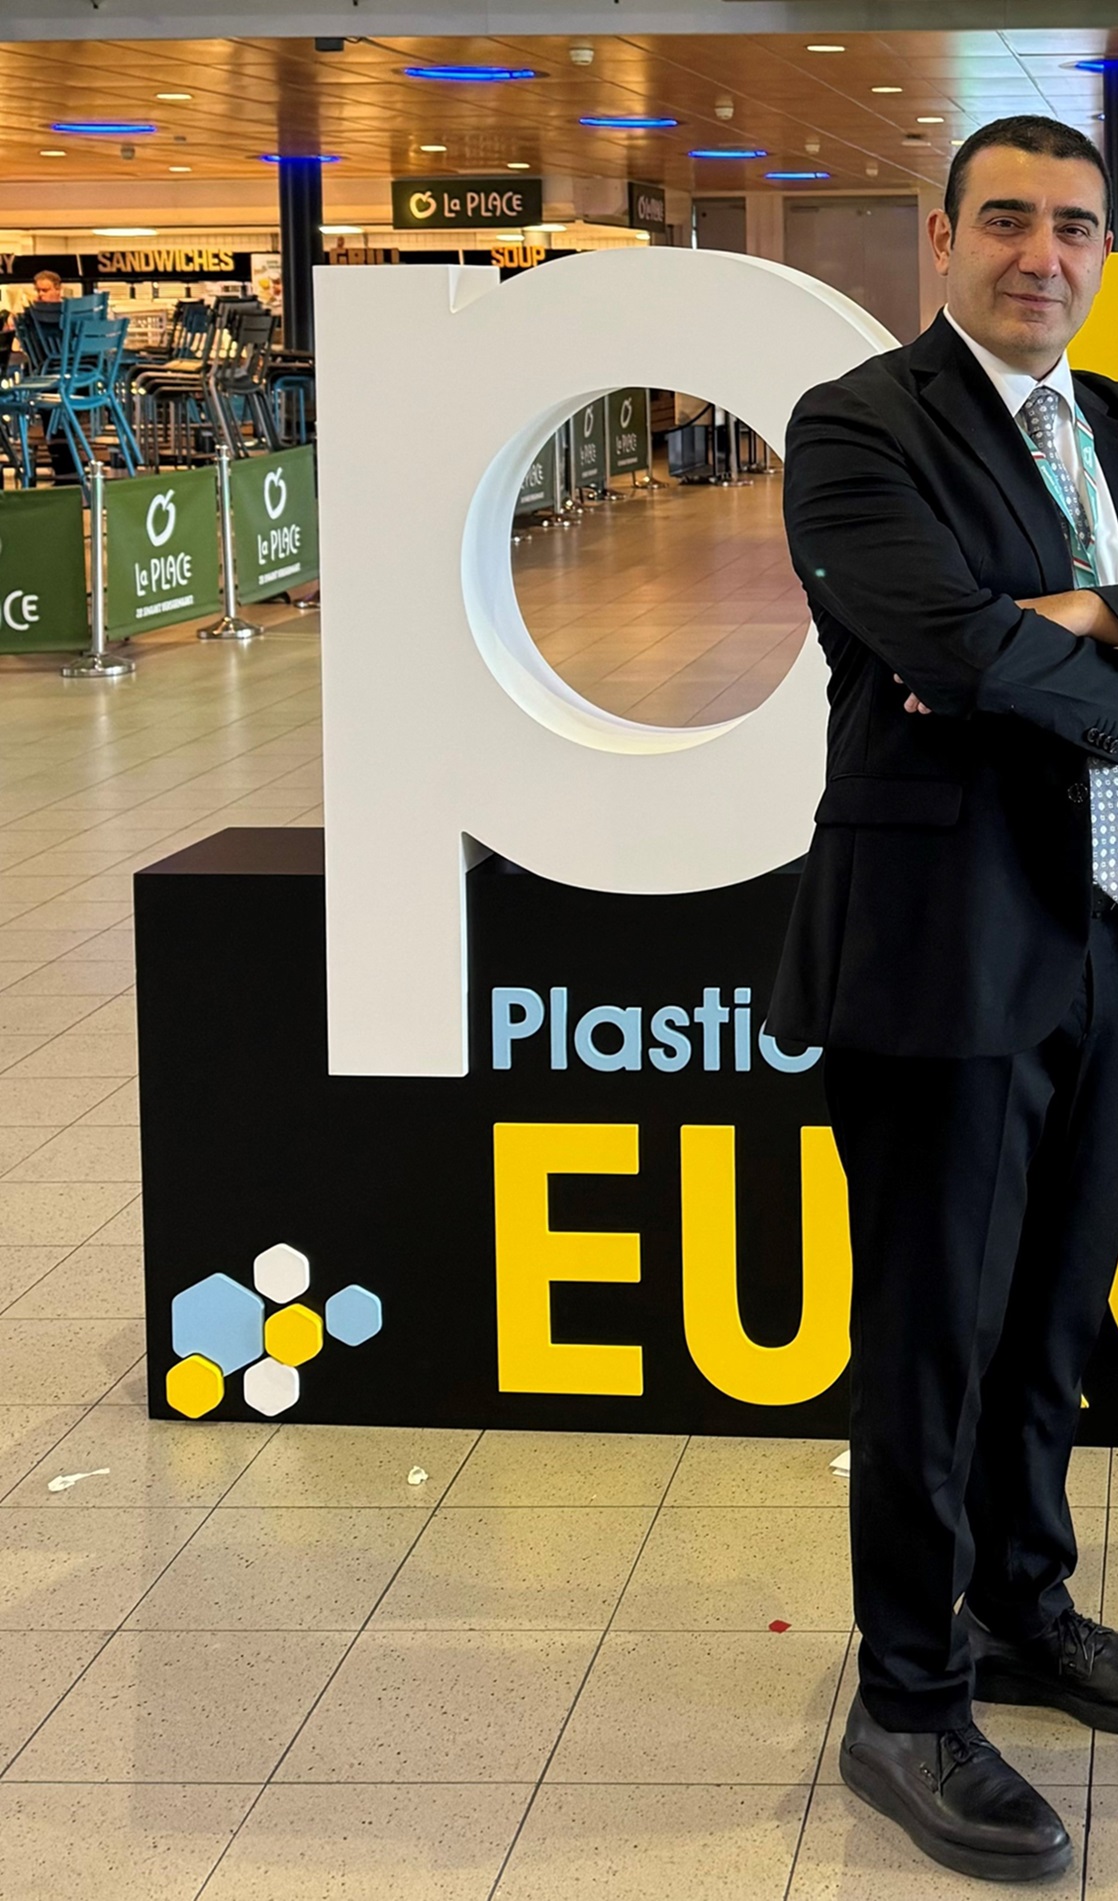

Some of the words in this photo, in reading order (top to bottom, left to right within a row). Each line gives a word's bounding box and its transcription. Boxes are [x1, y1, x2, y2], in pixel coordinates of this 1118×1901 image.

[466, 191, 523, 217] PLACE
[97, 250, 235, 272] SANDWICHES
[490, 245, 546, 268] SOUP
[257, 533, 269, 565] La
[271, 524, 301, 562] PLACE
[135, 563, 149, 597] La
[151, 552, 193, 593] PLACE
